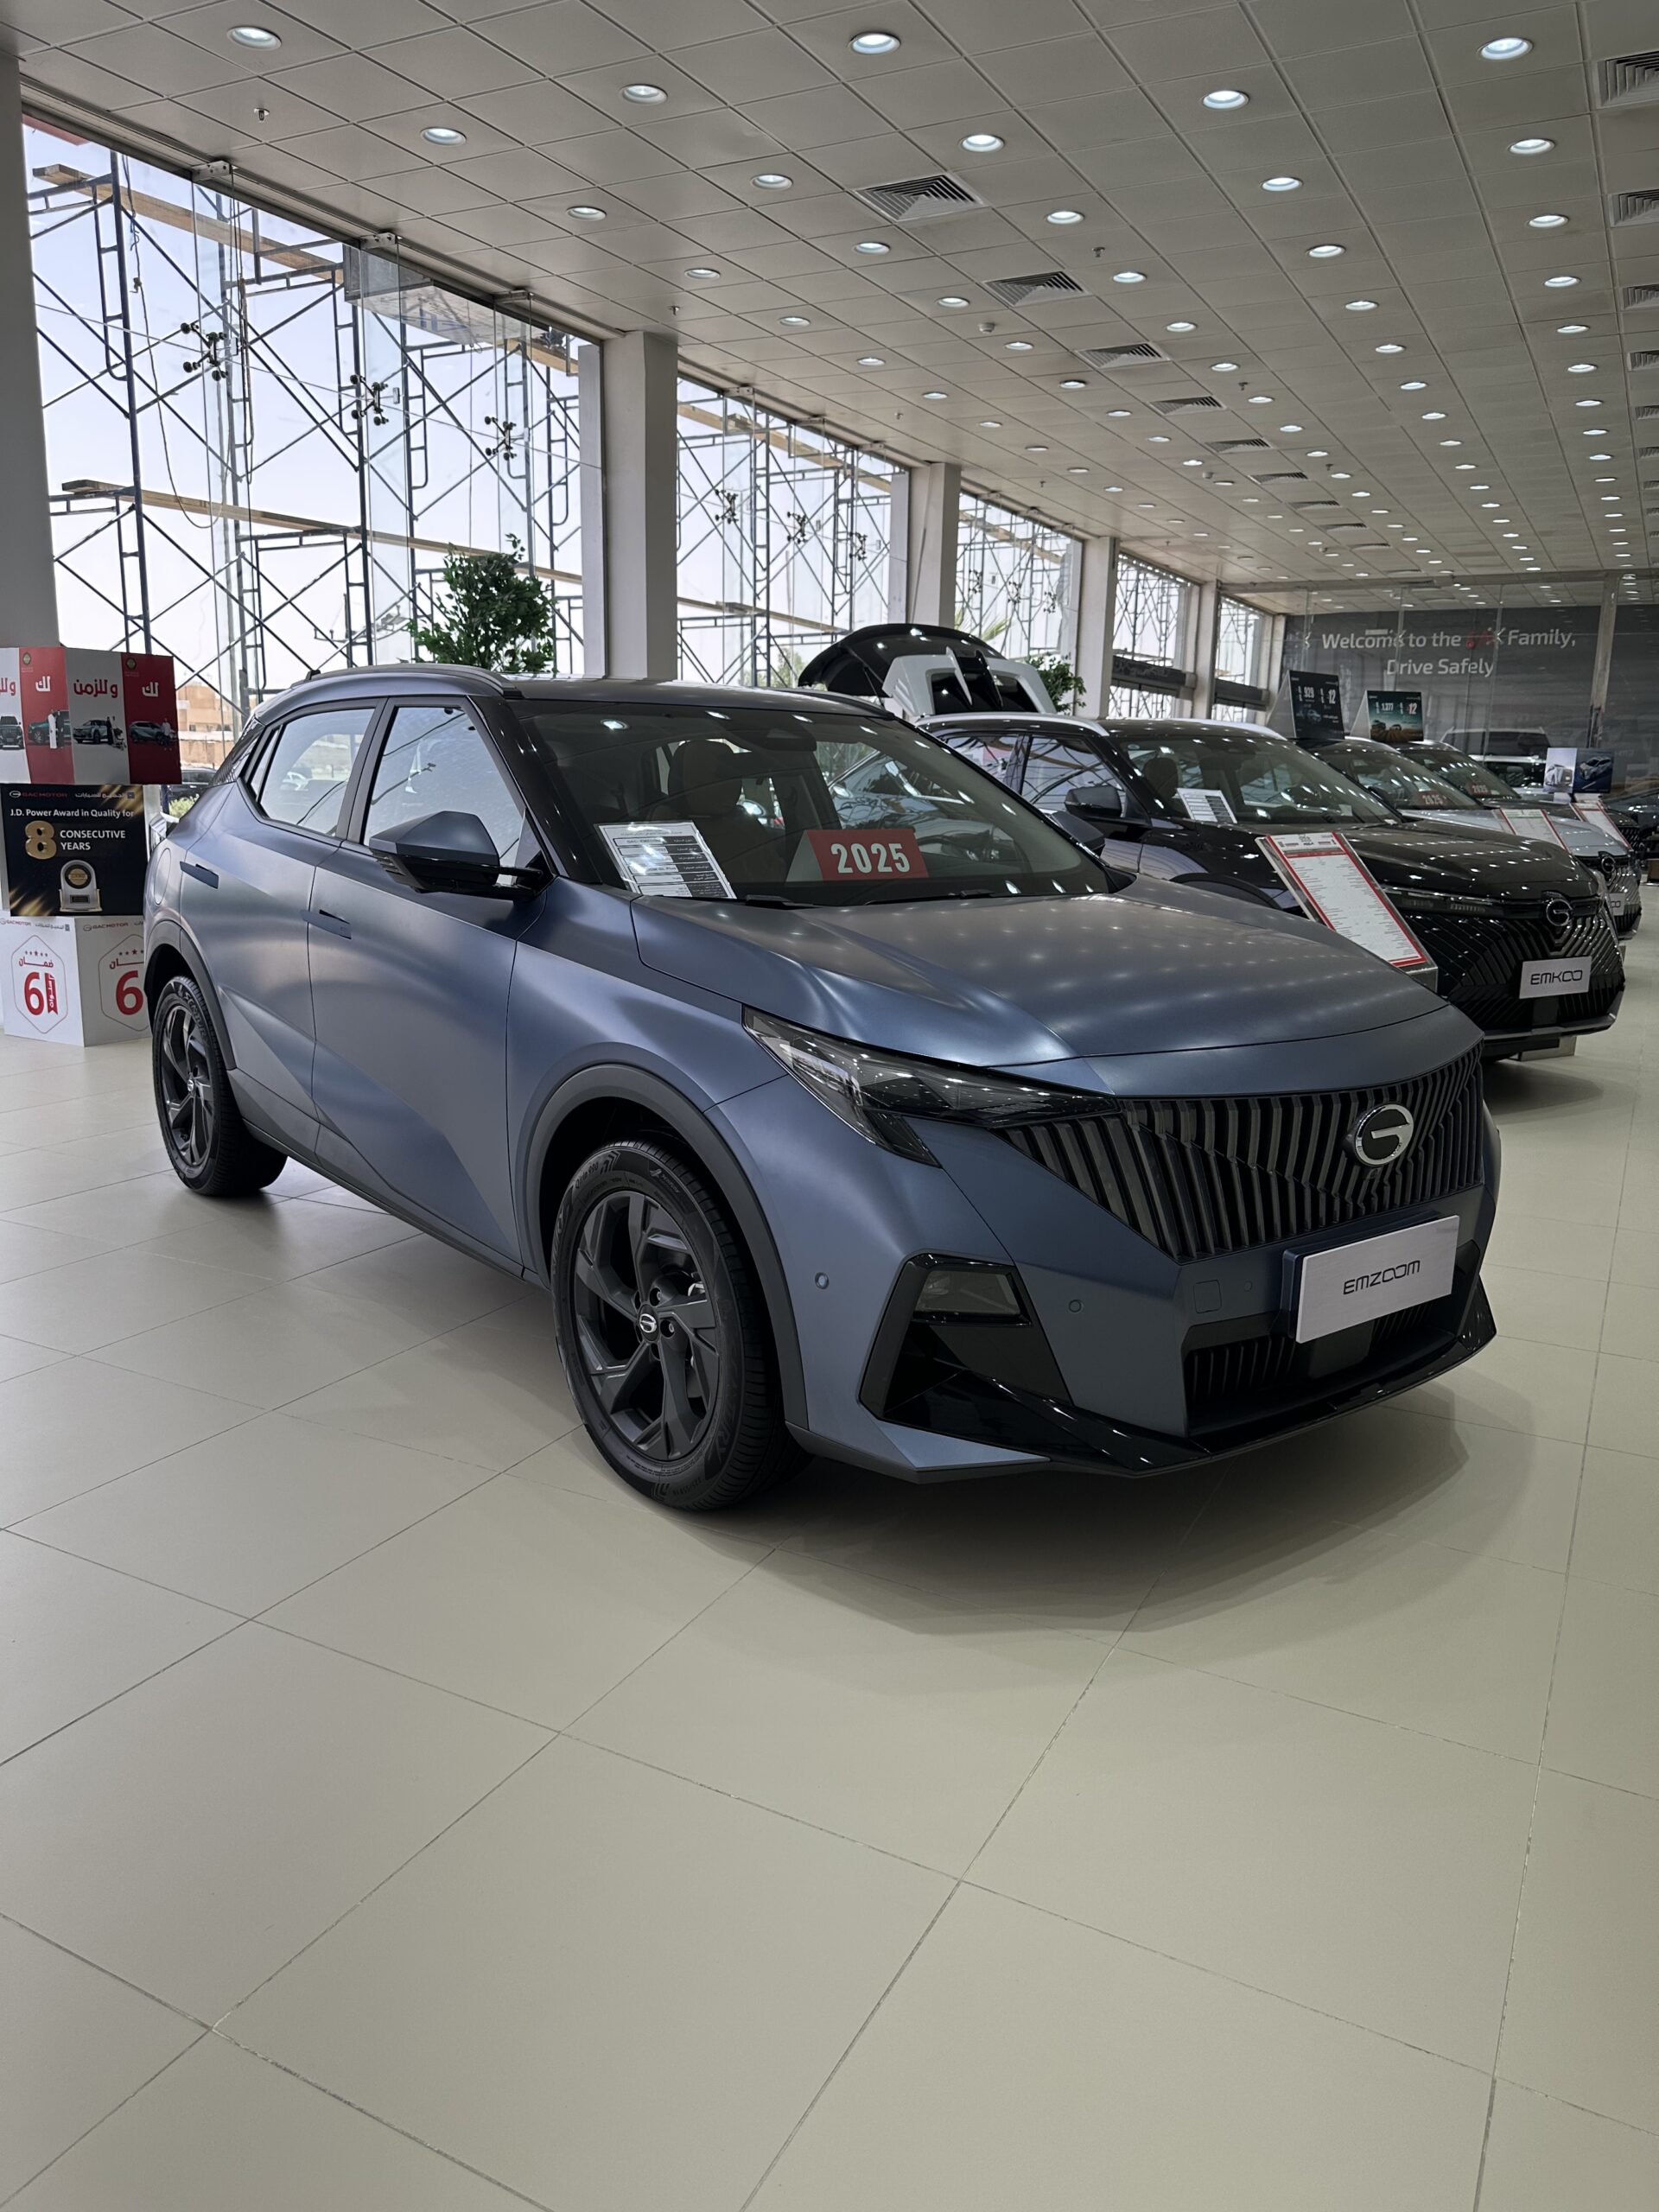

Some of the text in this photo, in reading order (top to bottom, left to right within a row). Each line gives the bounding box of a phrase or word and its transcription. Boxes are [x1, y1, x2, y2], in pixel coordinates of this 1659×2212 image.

[1408, 636, 1427, 647] to
[1432, 632, 1462, 647] the
[1508, 629, 1576, 649] Family,
[1387, 658, 1494, 677] Drive Safely
[91, 809, 120, 819] Quality
[24, 820, 57, 860] 8
[60, 830, 126, 839] CONSECUTIVE
[60, 842, 91, 851] YEARS
[830, 842, 911, 874] 2025
[1530, 969, 1583, 986] EMKOO
[23, 971, 44, 1016] 6
[116, 969, 144, 1015] 6
[1343, 1260, 1421, 1295] EMZOOM
